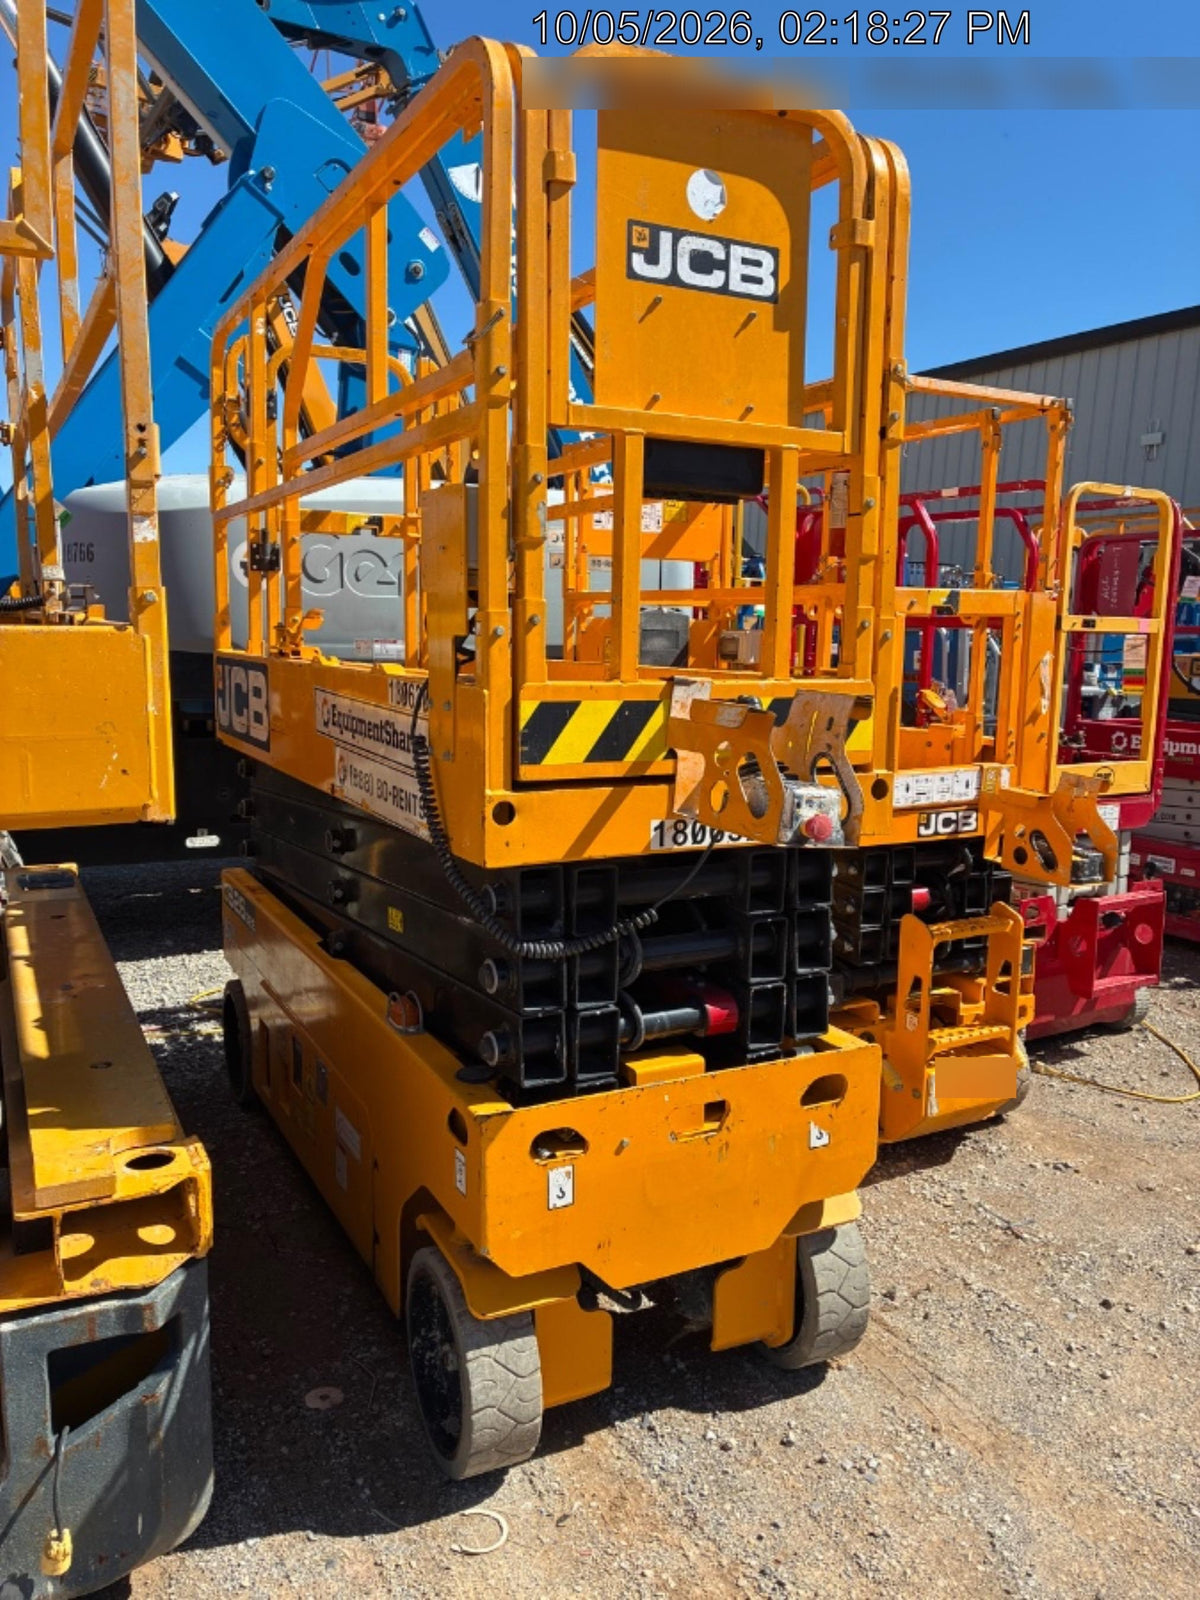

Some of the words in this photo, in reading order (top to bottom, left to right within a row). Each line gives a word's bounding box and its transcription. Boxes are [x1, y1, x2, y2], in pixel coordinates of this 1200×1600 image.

[631, 230, 776, 297] JCB
[217, 665, 268, 742] JCB
[331, 703, 413, 753] EquipmentShar
[919, 810, 977, 836] JCB
